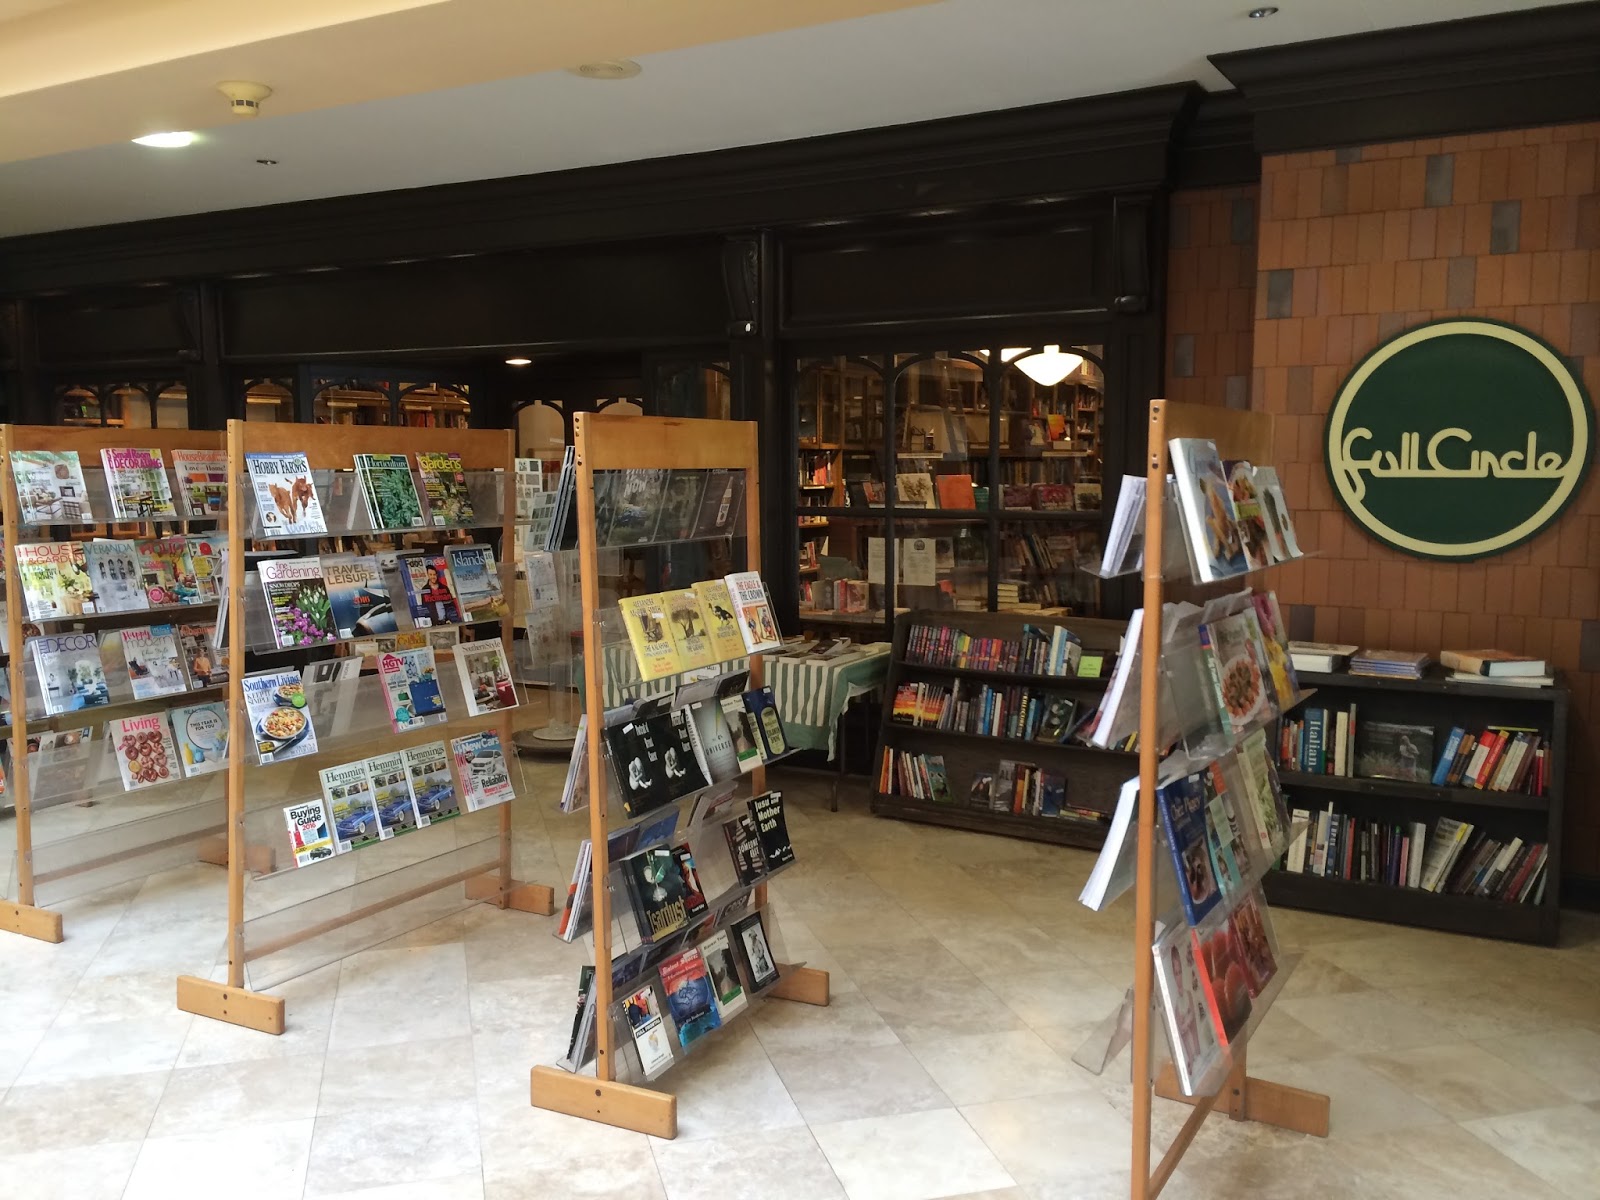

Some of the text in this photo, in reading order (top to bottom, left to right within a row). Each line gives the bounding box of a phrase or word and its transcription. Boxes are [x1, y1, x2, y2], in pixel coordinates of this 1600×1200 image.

[112, 448, 151, 459] Small Room
[1427, 427, 1564, 479] Circle
[114, 458, 162, 469] DECORATING
[252, 459, 308, 474] HOBBY FARMS
[367, 457, 408, 468] Horticulture
[624, 480, 647, 497] NOW
[24, 543, 84, 557] HOUSE
[82, 543, 134, 554] VERANDA
[275, 561, 288, 570] fine
[452, 550, 486, 567] Islands
[266, 565, 321, 580] Gardening
[327, 571, 377, 585] LEISURE
[739, 591, 749, 601] THE
[121, 630, 151, 641] Happy
[47, 634, 97, 653] DECOR
[382, 658, 405, 668] HGTV
[244, 674, 300, 692] Southern Living
[122, 716, 161, 733] Living
[462, 741, 482, 752] New
[481, 737, 500, 748] Cars
[705, 740, 732, 756] UNIVERSE
[1308, 721, 1322, 766] Italian
[406, 746, 445, 762] Hemmings
[368, 757, 402, 773] Hemmin
[290, 806, 321, 820] Buying
[297, 814, 322, 826] Guide
[757, 806, 781, 822] Mother
[302, 822, 317, 831] 2016
[760, 818, 777, 833] Earth
